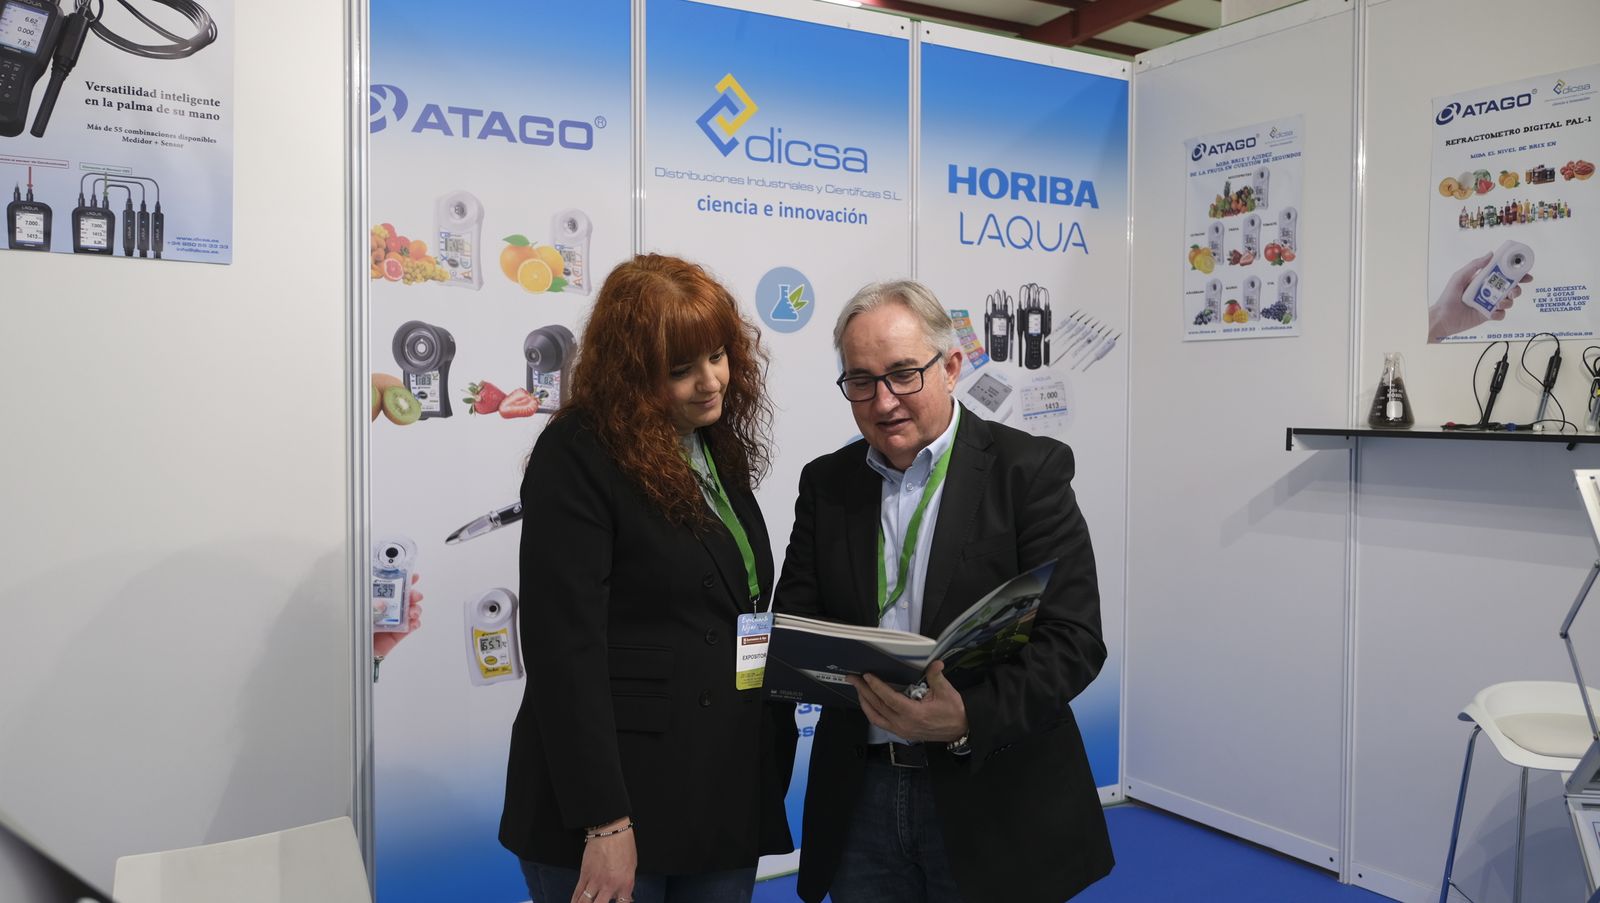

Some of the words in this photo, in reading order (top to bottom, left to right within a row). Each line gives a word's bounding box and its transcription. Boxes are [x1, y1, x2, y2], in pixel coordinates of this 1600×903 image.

[85, 80, 157, 99] Versatilidad
[160, 90, 221, 107] inteligente
[1461, 92, 1532, 119] ATAGO
[84, 98, 99, 106] en
[102, 97, 113, 107] la
[116, 100, 153, 112] palma
[156, 104, 170, 114] de
[172, 107, 185, 117] su
[188, 109, 220, 121] mano
[87, 122, 102, 132] Más
[103, 124, 113, 132] de
[124, 127, 177, 139] combinaciones
[178, 133, 217, 144] disponibles
[122, 135, 153, 145] Medidor
[160, 139, 184, 149] Sensor
[1445, 127, 1521, 147] REFRACTOMETRO
[1523, 120, 1563, 134] DIGITAL
[1565, 115, 1592, 127] PAL-1
[744, 126, 869, 174] dicsa
[1207, 136, 1257, 156] ATAGO
[654, 166, 745, 186] Distribuciones
[746, 177, 815, 192] Industriales
[816, 184, 823, 194] y
[948, 163, 1100, 210] HORIBA
[696, 194, 758, 216] ciencia
[763, 204, 774, 217] e
[778, 201, 868, 225] innovación
[960, 210, 1089, 255] LAQUA
[742, 652, 767, 661] EXPOSITOR
